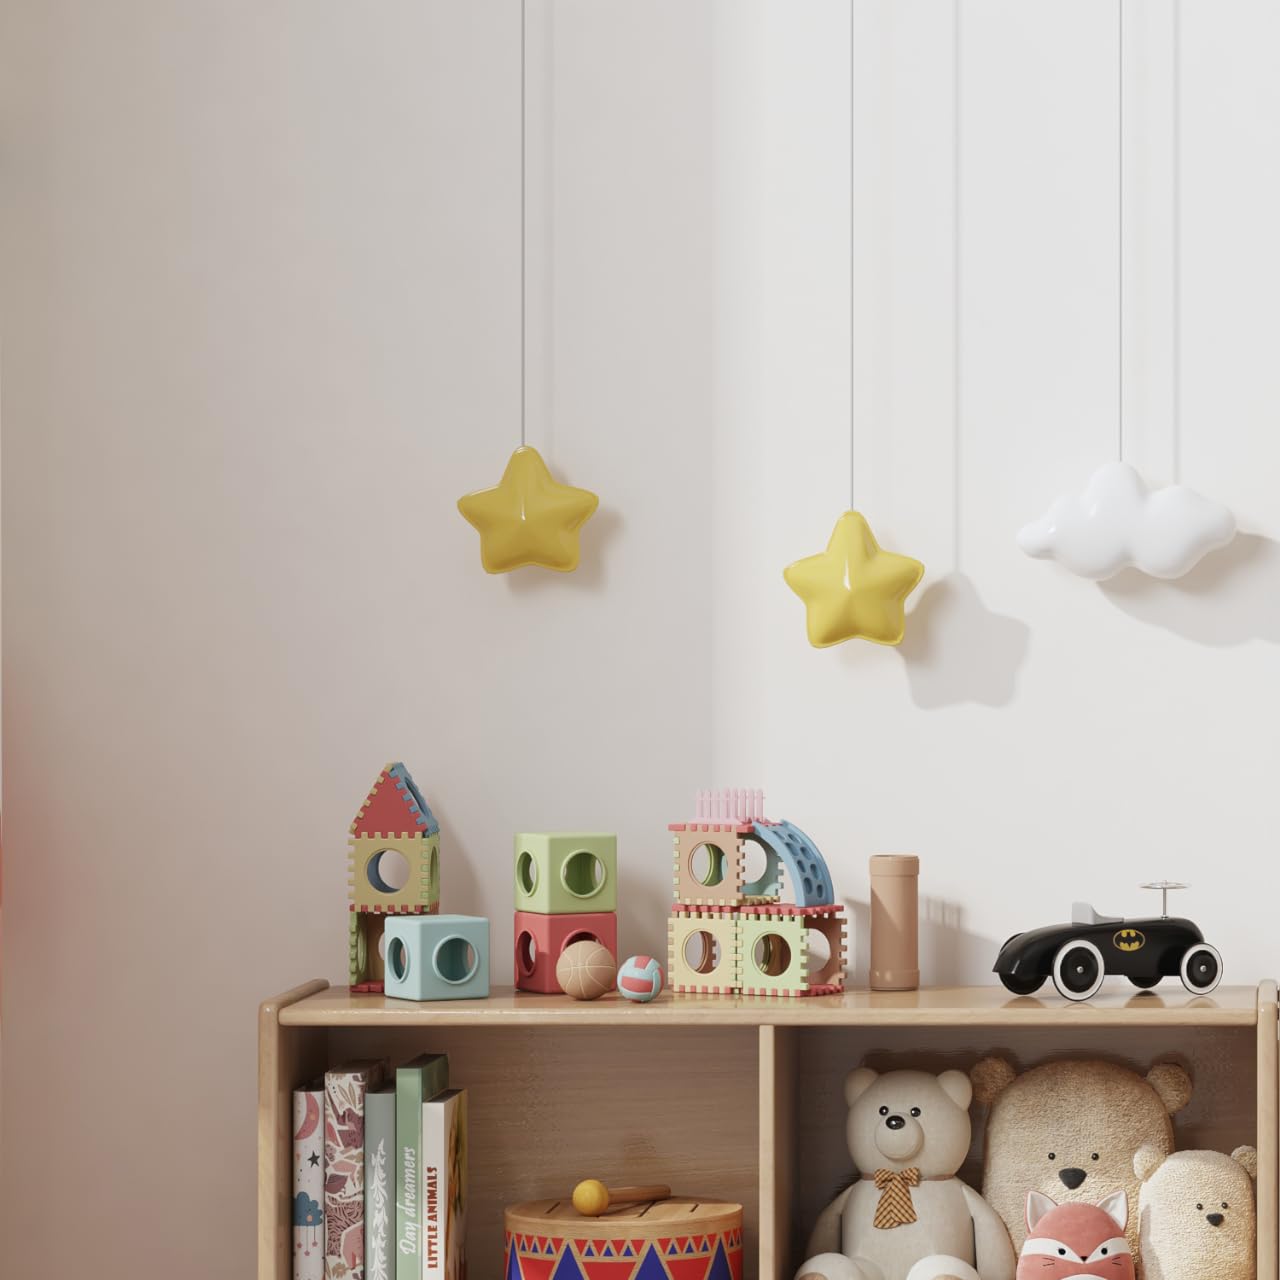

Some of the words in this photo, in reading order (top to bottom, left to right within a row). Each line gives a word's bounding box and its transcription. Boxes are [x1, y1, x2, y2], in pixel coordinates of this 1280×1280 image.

[396, 1146, 416, 1218] dreamers
[426, 1166, 438, 1222] ANIMALS
[399, 1221, 421, 1255] Day
[427, 1225, 438, 1269] LITTLE
